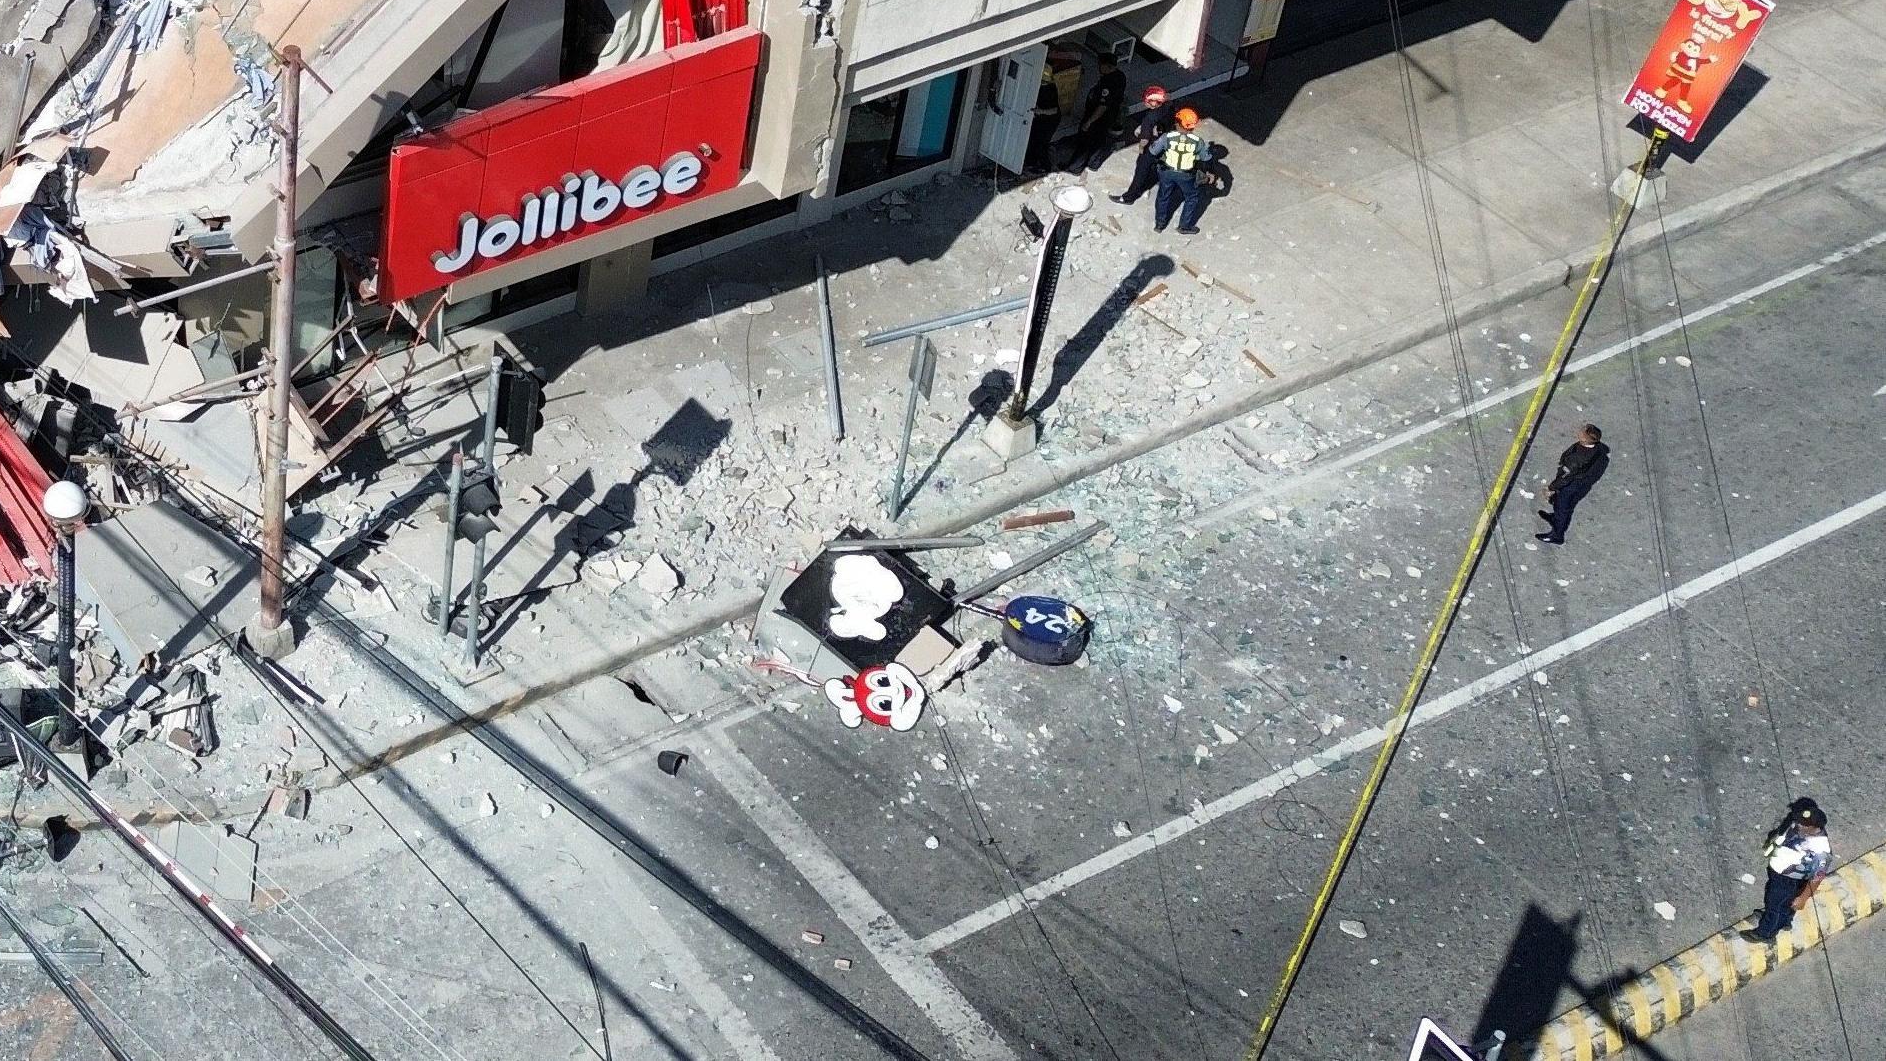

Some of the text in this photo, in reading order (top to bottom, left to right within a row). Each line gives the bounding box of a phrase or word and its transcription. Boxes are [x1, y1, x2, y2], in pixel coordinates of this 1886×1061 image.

[1635, 89, 1692, 127] NOW OPEN
[432, 151, 702, 273] Jollibee
[1025, 607, 1066, 634] 24
